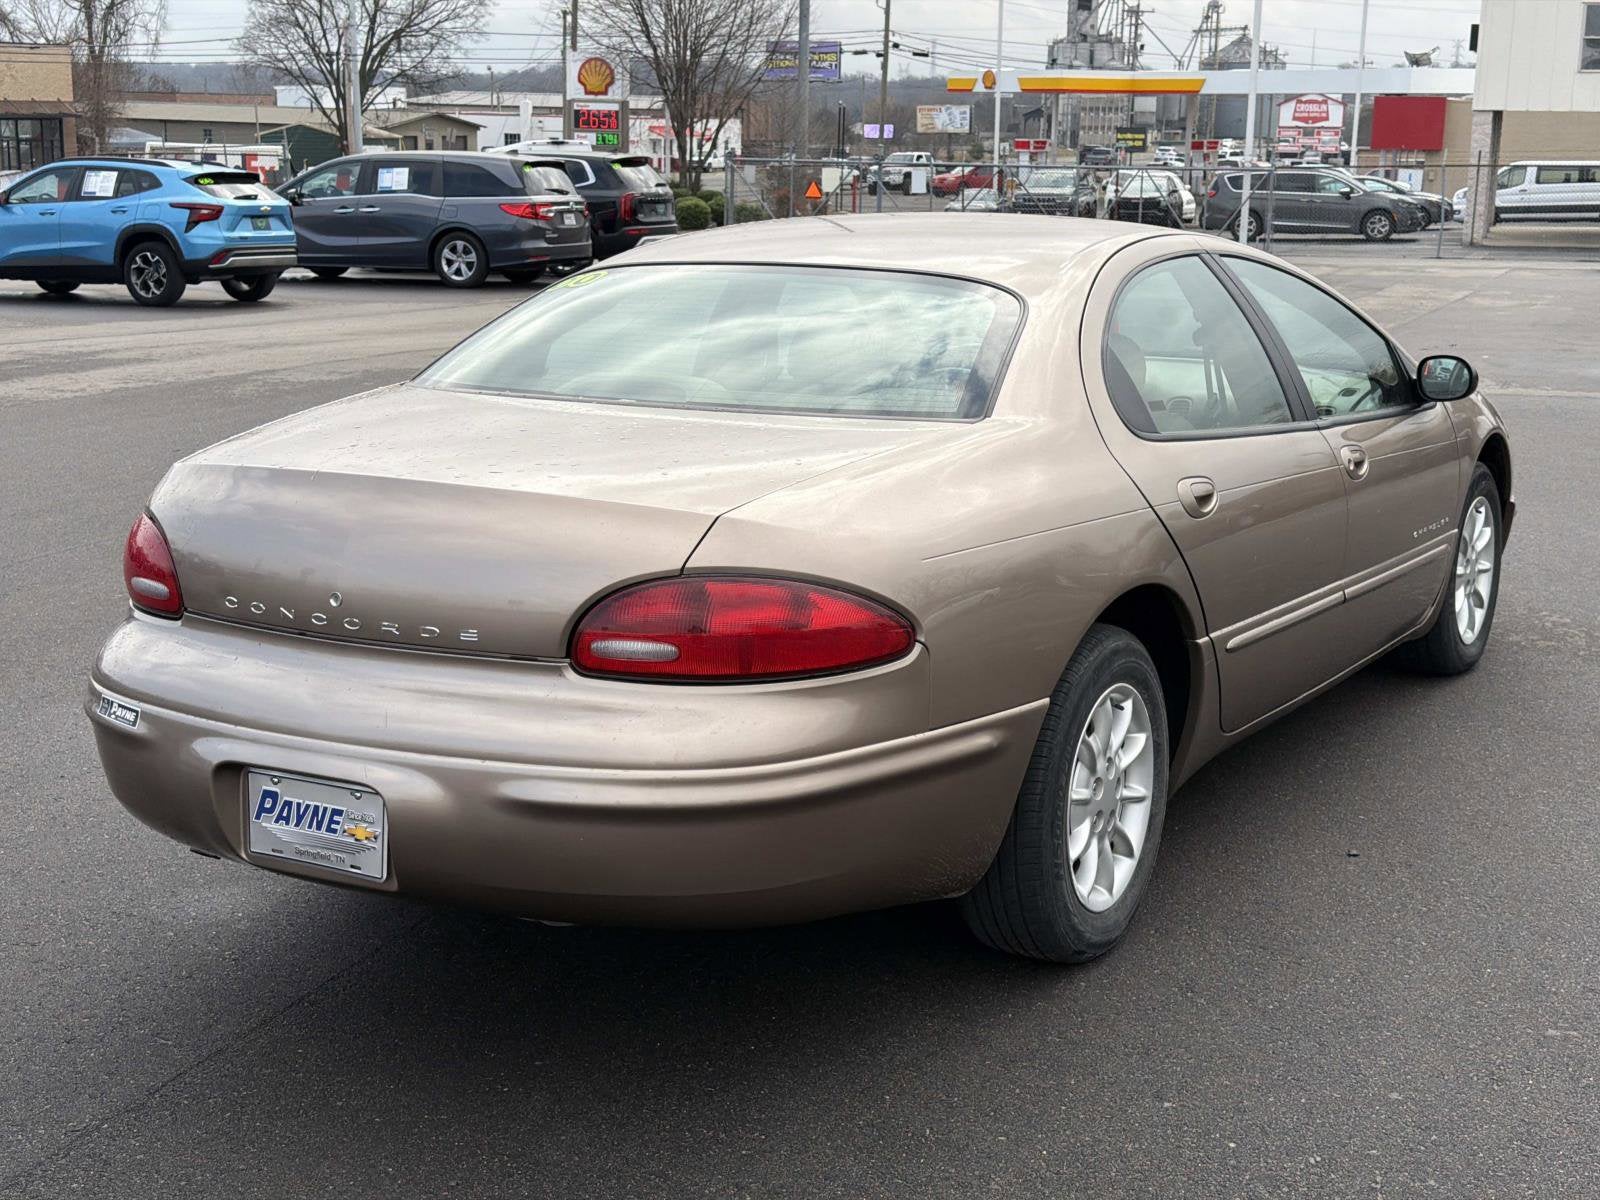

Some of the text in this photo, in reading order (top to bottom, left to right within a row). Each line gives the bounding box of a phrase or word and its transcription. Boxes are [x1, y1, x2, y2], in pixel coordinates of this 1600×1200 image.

[224, 596, 479, 642] CONCORDE
[110, 702, 137, 722] PAYNE
[253, 787, 346, 835] PAYNE
[335, 854, 346, 864] TN
